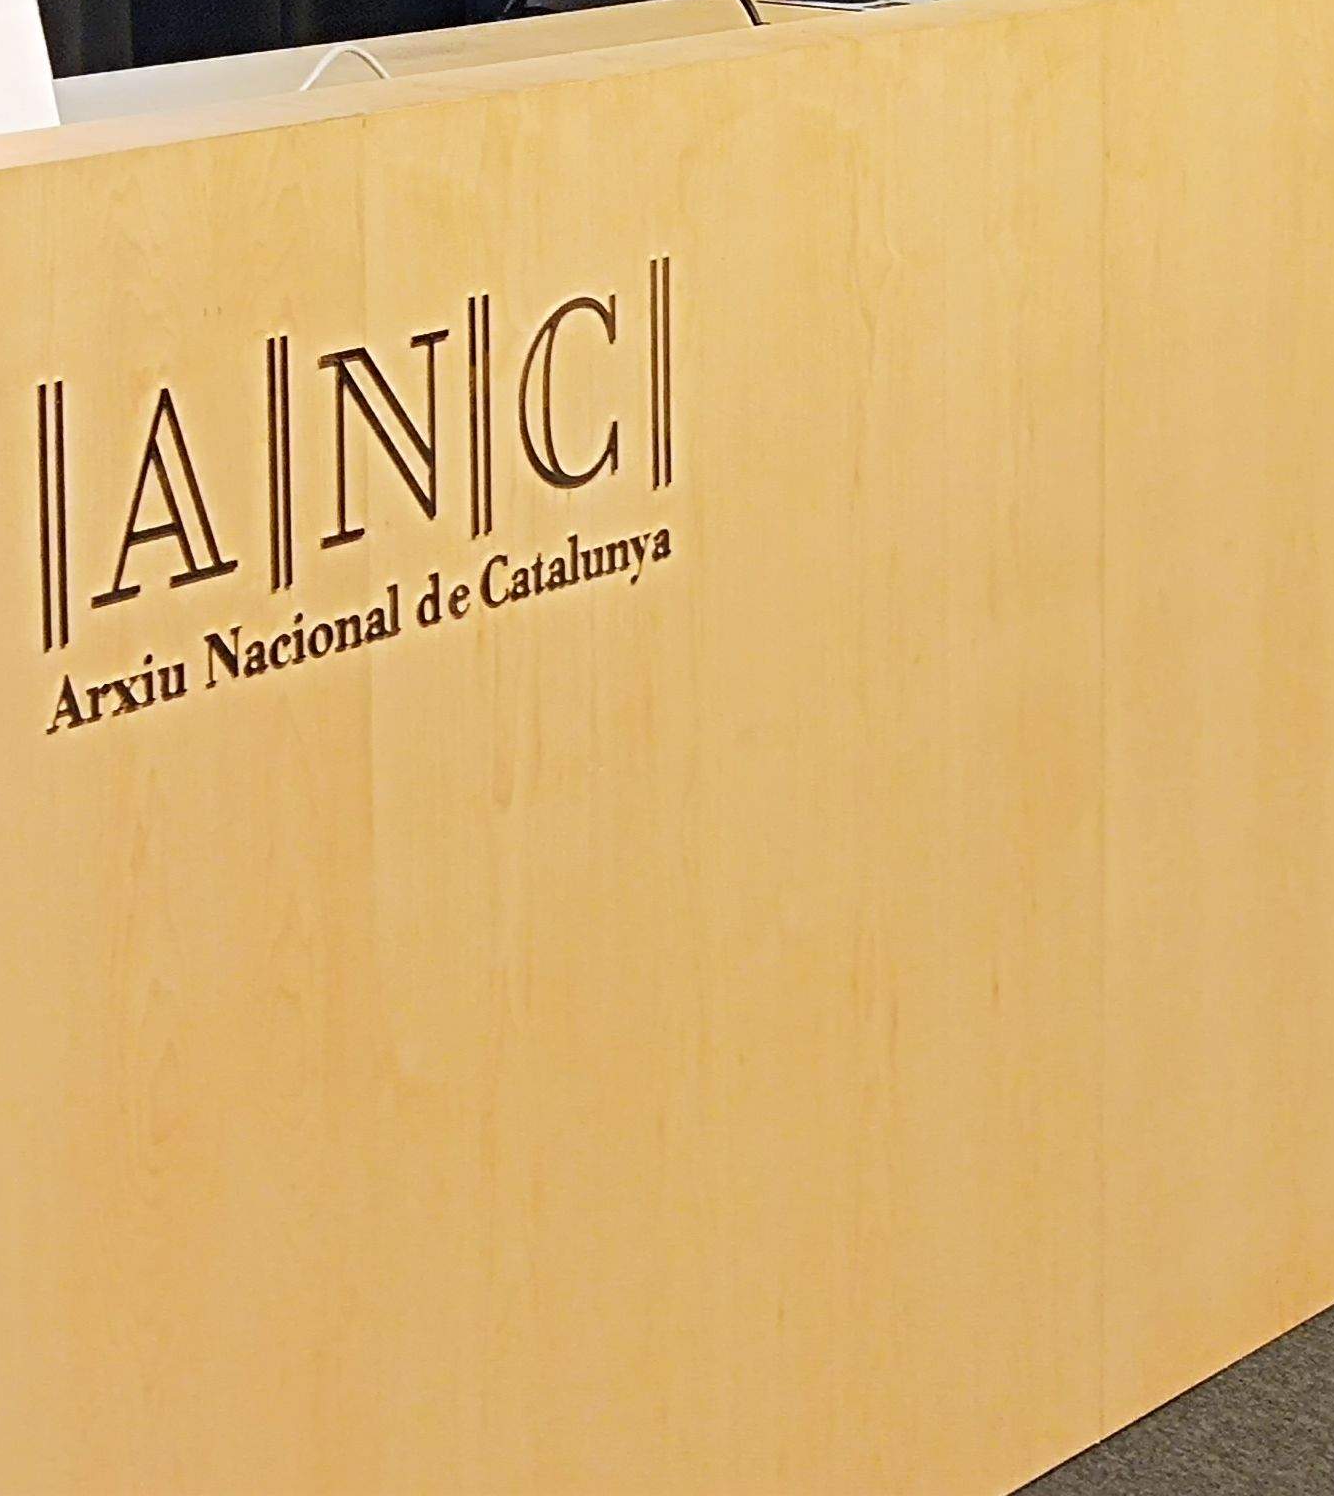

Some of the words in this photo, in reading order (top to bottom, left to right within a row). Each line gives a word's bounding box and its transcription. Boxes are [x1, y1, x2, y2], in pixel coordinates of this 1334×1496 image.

[46, 654, 187, 735] Arxiu
[204, 584, 402, 690] Nacional
[415, 572, 470, 629] de
[478, 524, 673, 609] Catalunya
